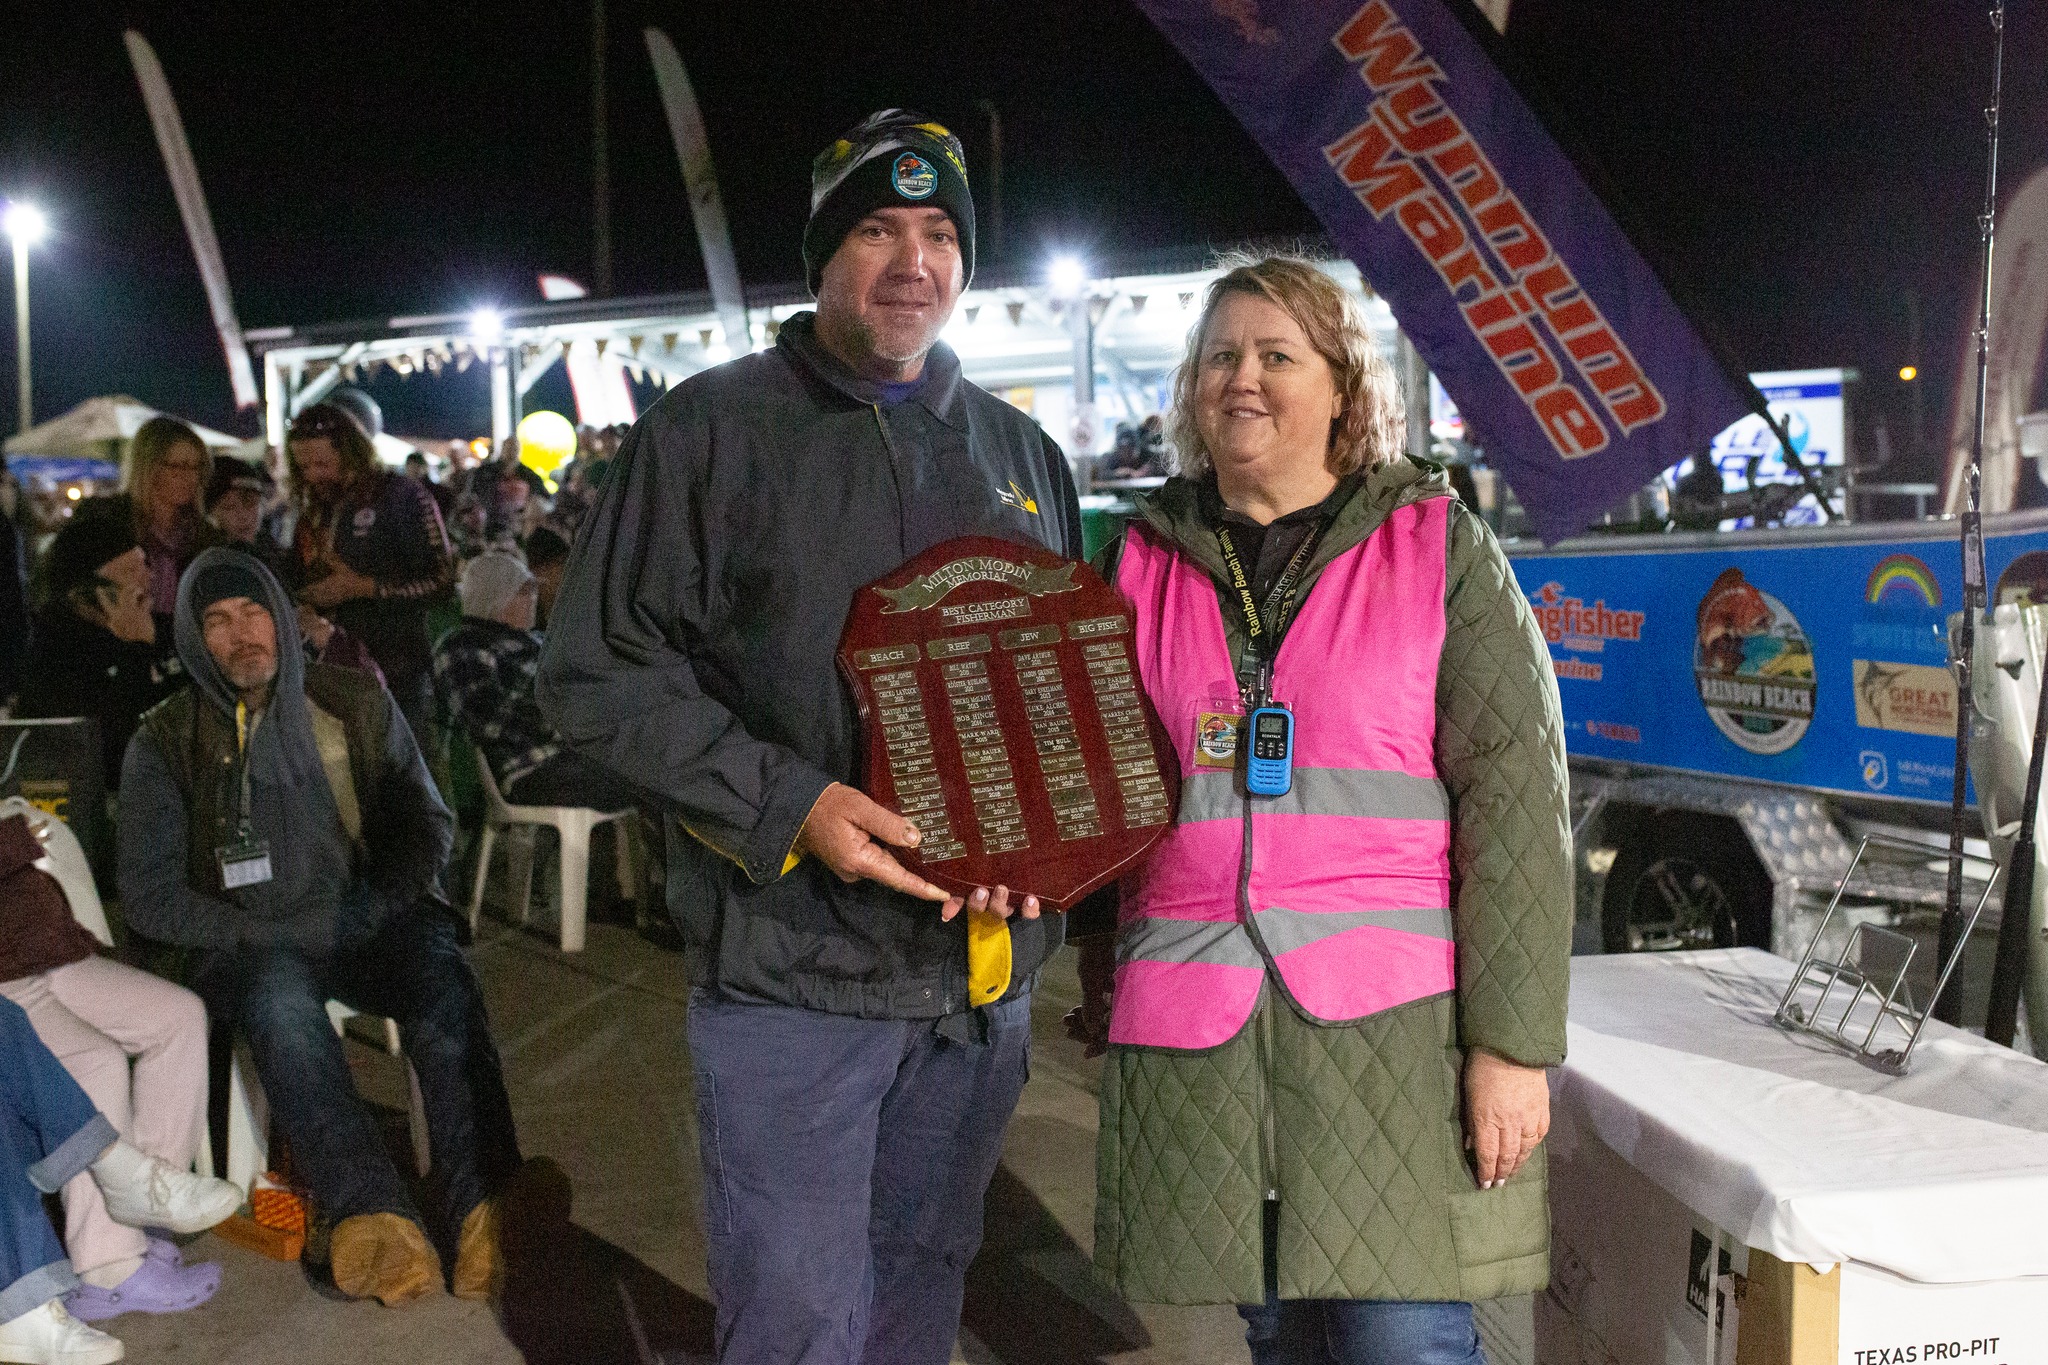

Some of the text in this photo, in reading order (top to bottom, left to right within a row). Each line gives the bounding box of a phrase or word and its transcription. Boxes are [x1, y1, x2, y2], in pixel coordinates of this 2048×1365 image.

[1332, 0, 1667, 438] Wynnum
[1322, 119, 1610, 460] Marine
[921, 559, 1032, 593] MILTON MODIN
[946, 571, 1009, 588] MEMORIAL
[1220, 529, 1262, 637] Rainbow Beach Family
[1270, 572, 1293, 601] BEACH
[942, 598, 1025, 616] BEST CATEGORY
[1277, 589, 1296, 632] & Expo
[956, 609, 1017, 624] FISHERMAN
[1531, 598, 1645, 643] ngfisher
[1078, 621, 1118, 633] BIG FISH
[1020, 632, 1039, 641] JEW
[947, 642, 970, 651] REEF
[870, 650, 905, 662] BEACH
[1889, 686, 1951, 705] GREAT
[973, 712, 994, 720] HINCH
[886, 722, 925, 734] WAYNE YOUNG
[931, 829, 948, 837] BYRNE
[1854, 1337, 2000, 1365] TEXAS PRO-PIT
